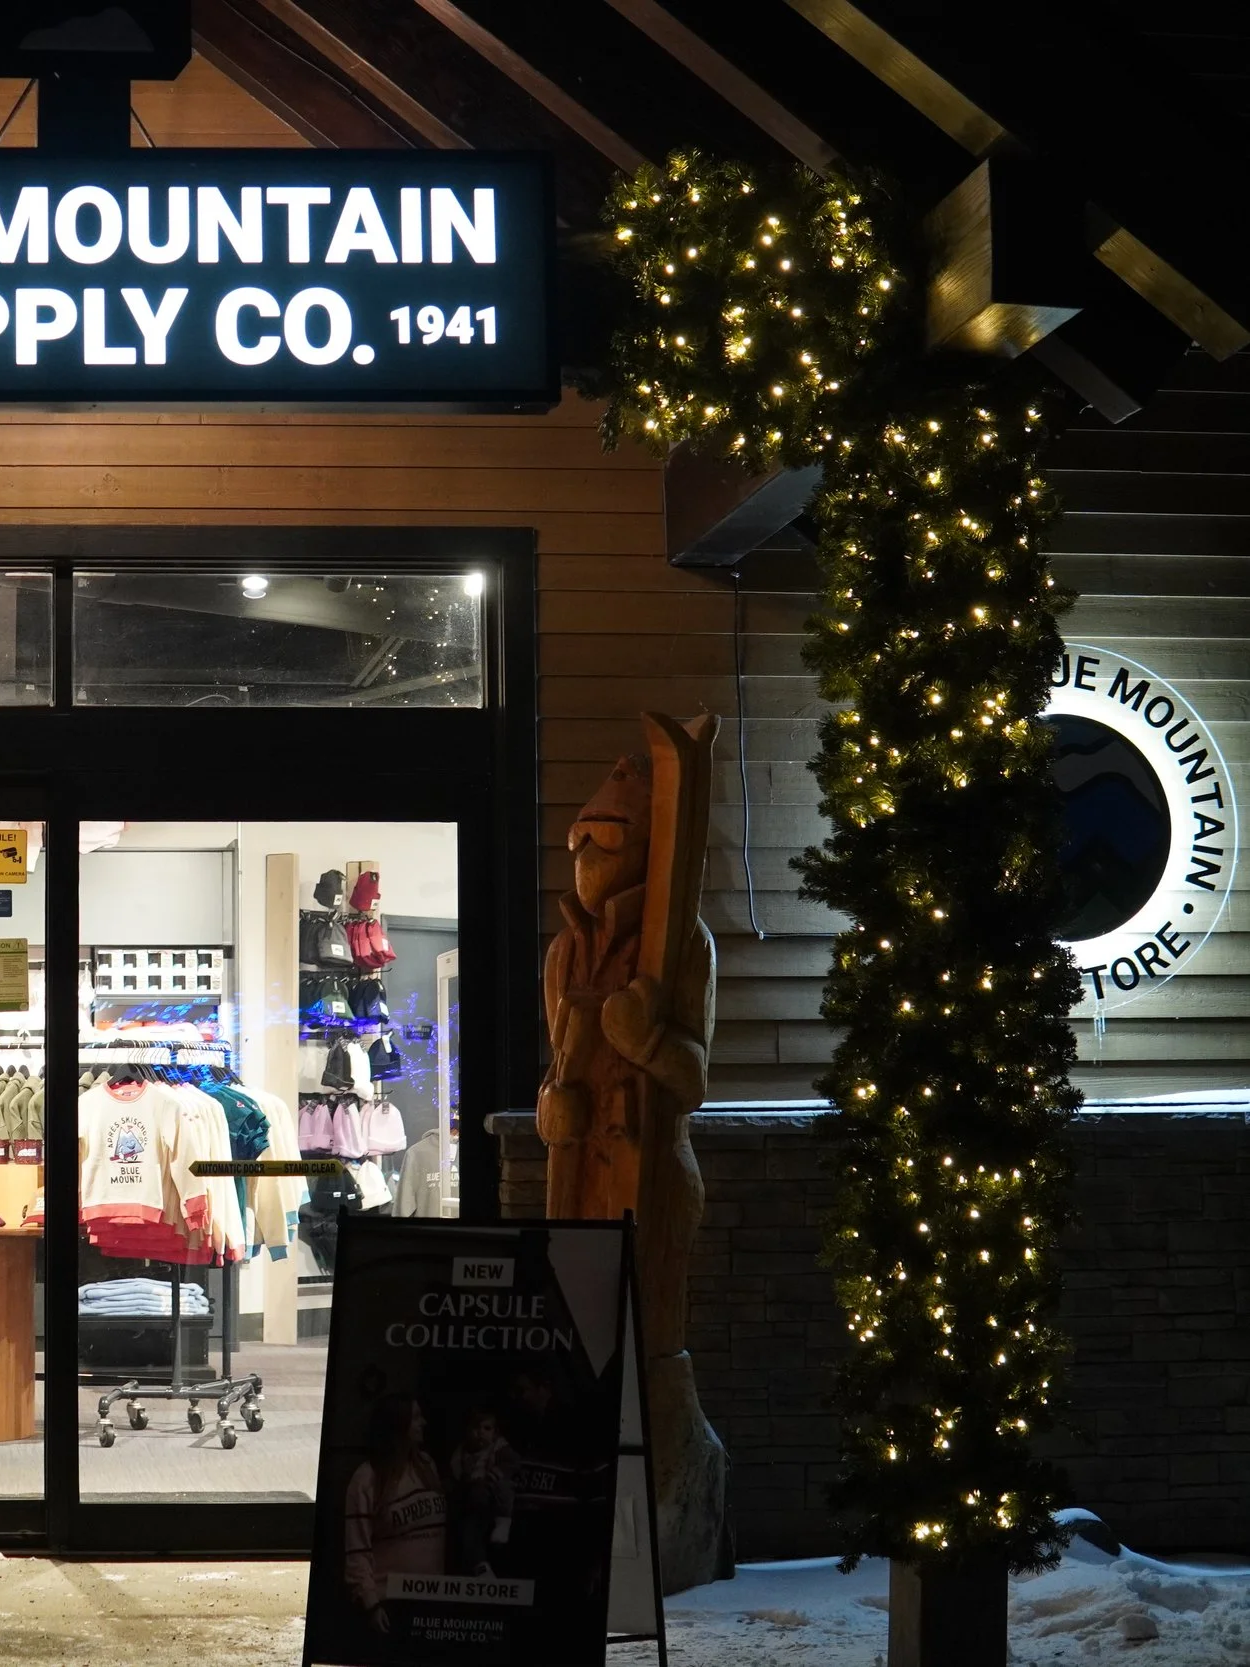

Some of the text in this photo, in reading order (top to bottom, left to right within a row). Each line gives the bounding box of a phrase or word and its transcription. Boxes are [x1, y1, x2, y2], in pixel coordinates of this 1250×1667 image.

[215, 287, 376, 367] CO.
[390, 306, 496, 345] 1941
[1050, 654, 1226, 892] UE MOUNTAIN
[1082, 920, 1192, 1000] TORE
[120, 1167, 140, 1175] BLUE
[197, 1163, 336, 1173] AUTOMATIC DOOR STAND CLEAR
[463, 1264, 503, 1279] NEW
[418, 1292, 546, 1319] CAPSULE
[385, 1323, 573, 1352] COLLECTION
[402, 1579, 519, 1598] NOW IN STORE
[413, 1616, 503, 1631] BLUE MOUNTAIN
[424, 1629, 467, 1641] SUPPLY
